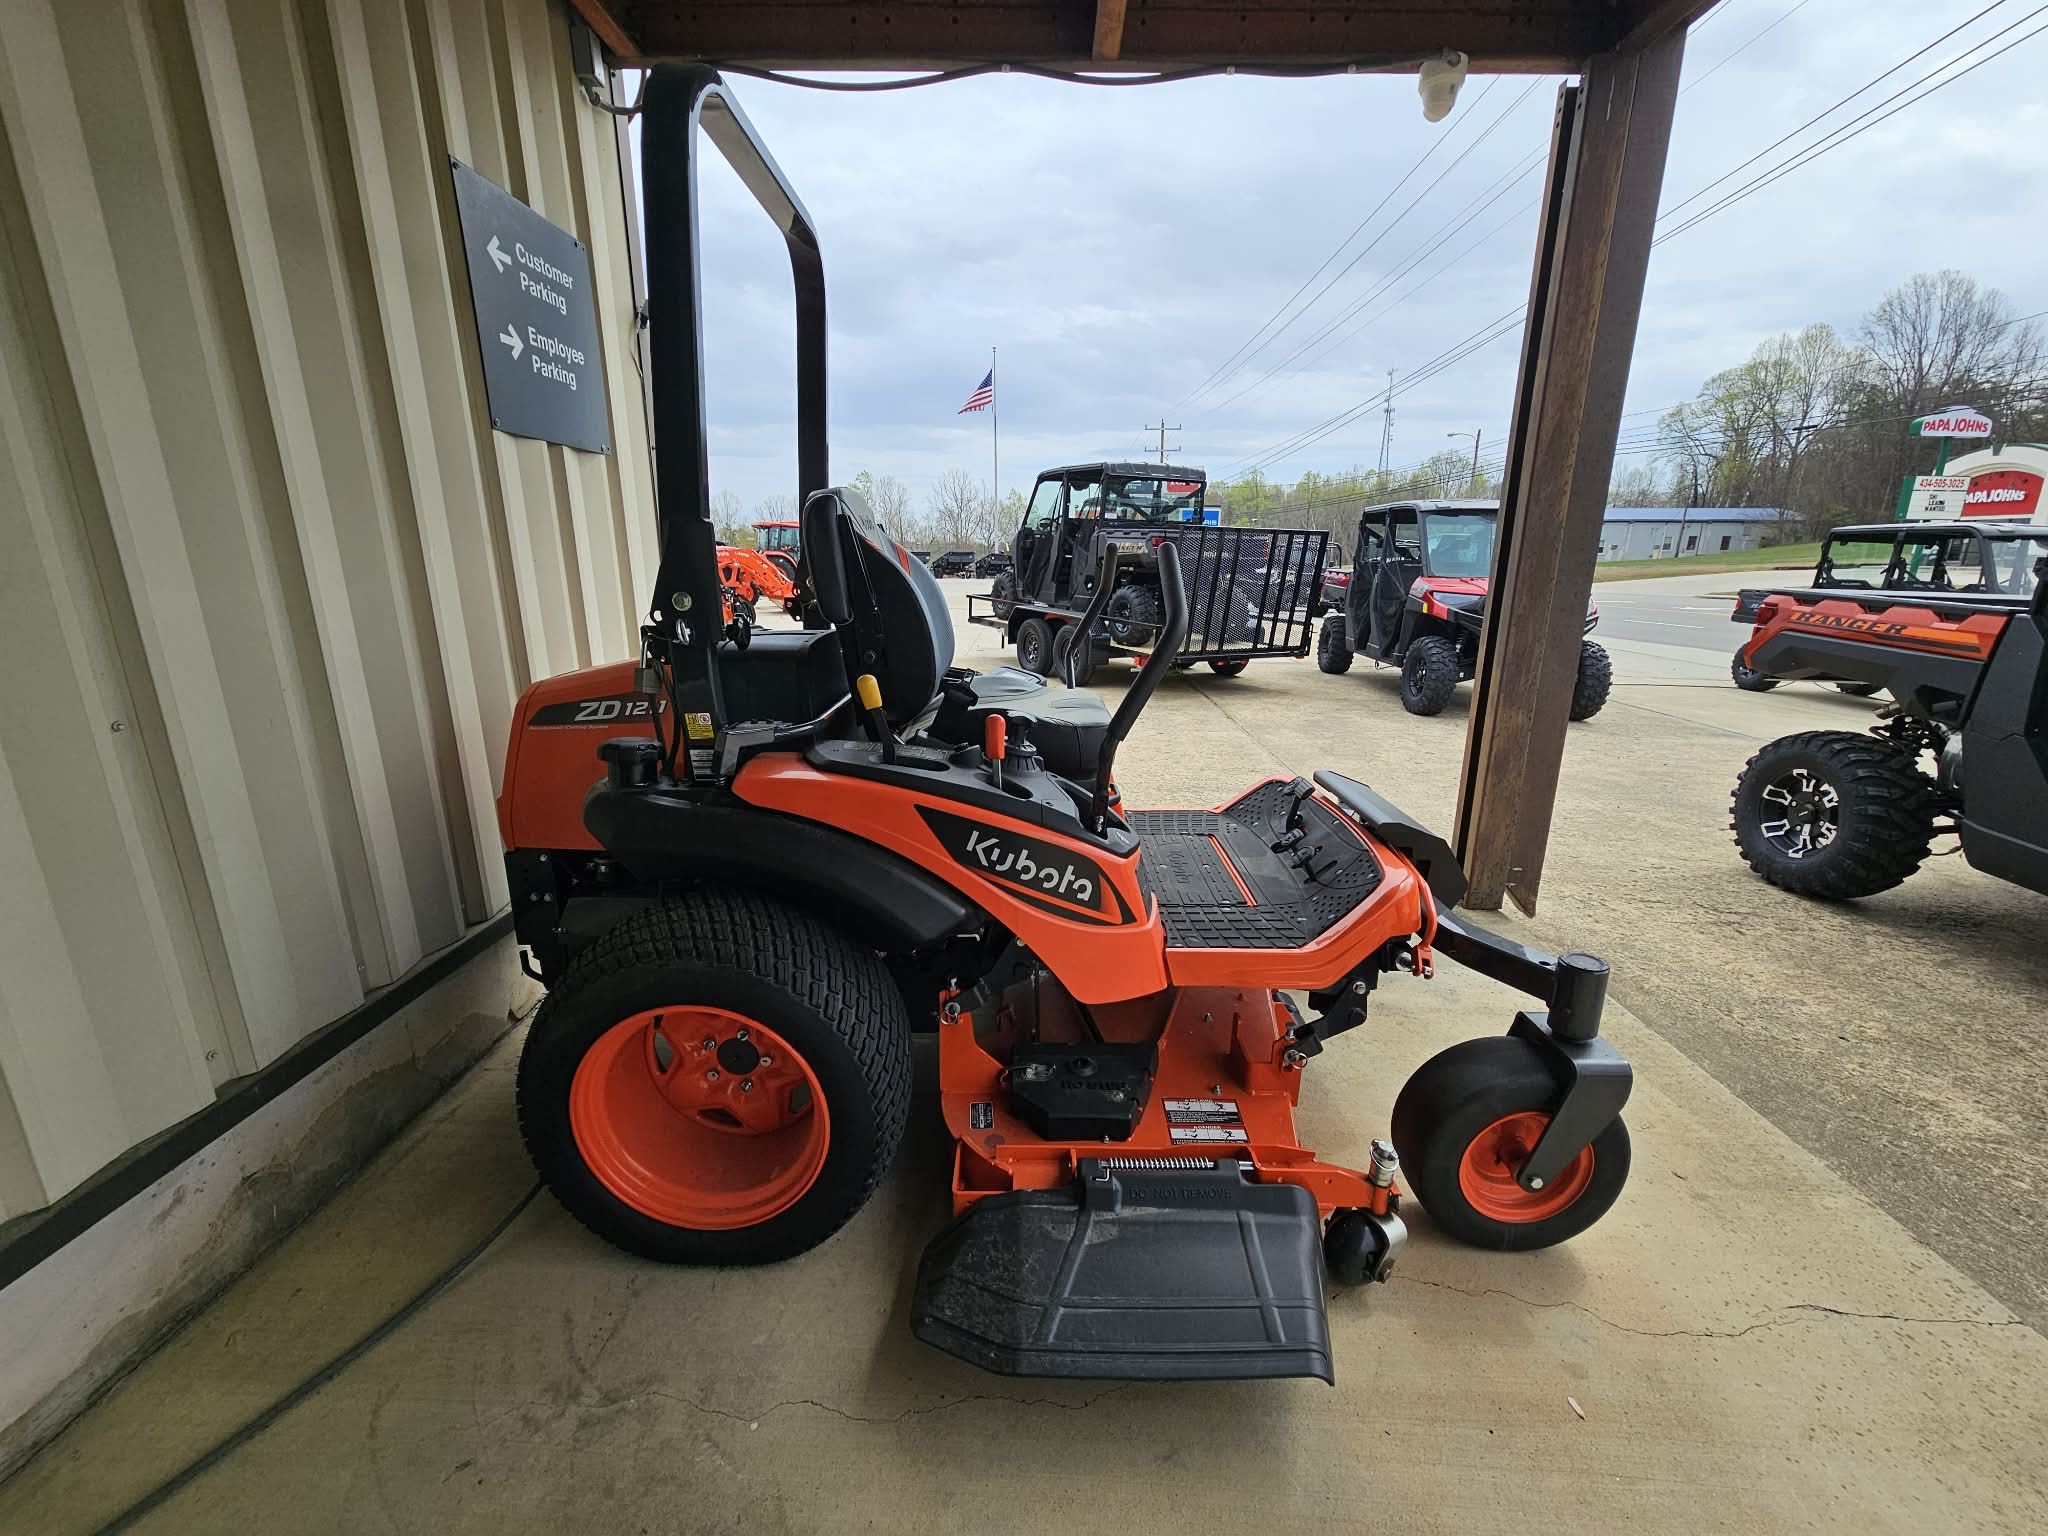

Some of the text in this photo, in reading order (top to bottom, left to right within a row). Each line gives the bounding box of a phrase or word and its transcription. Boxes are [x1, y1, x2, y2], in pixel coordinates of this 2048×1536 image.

[514, 242, 574, 290] Customer
[520, 271, 567, 316] Parking
[527, 325, 585, 365] Employee
[532, 354, 577, 391] Parking
[1923, 418, 1989, 432] PAPA JOHNS
[1988, 489, 2026, 502] JOHNS
[1796, 611, 1909, 635] RANGER
[574, 700, 667, 721] ZD121
[966, 830, 1093, 901] Kubota
[1154, 1188, 1177, 1199] NOT
[1182, 1188, 1232, 1199] REMOVE
